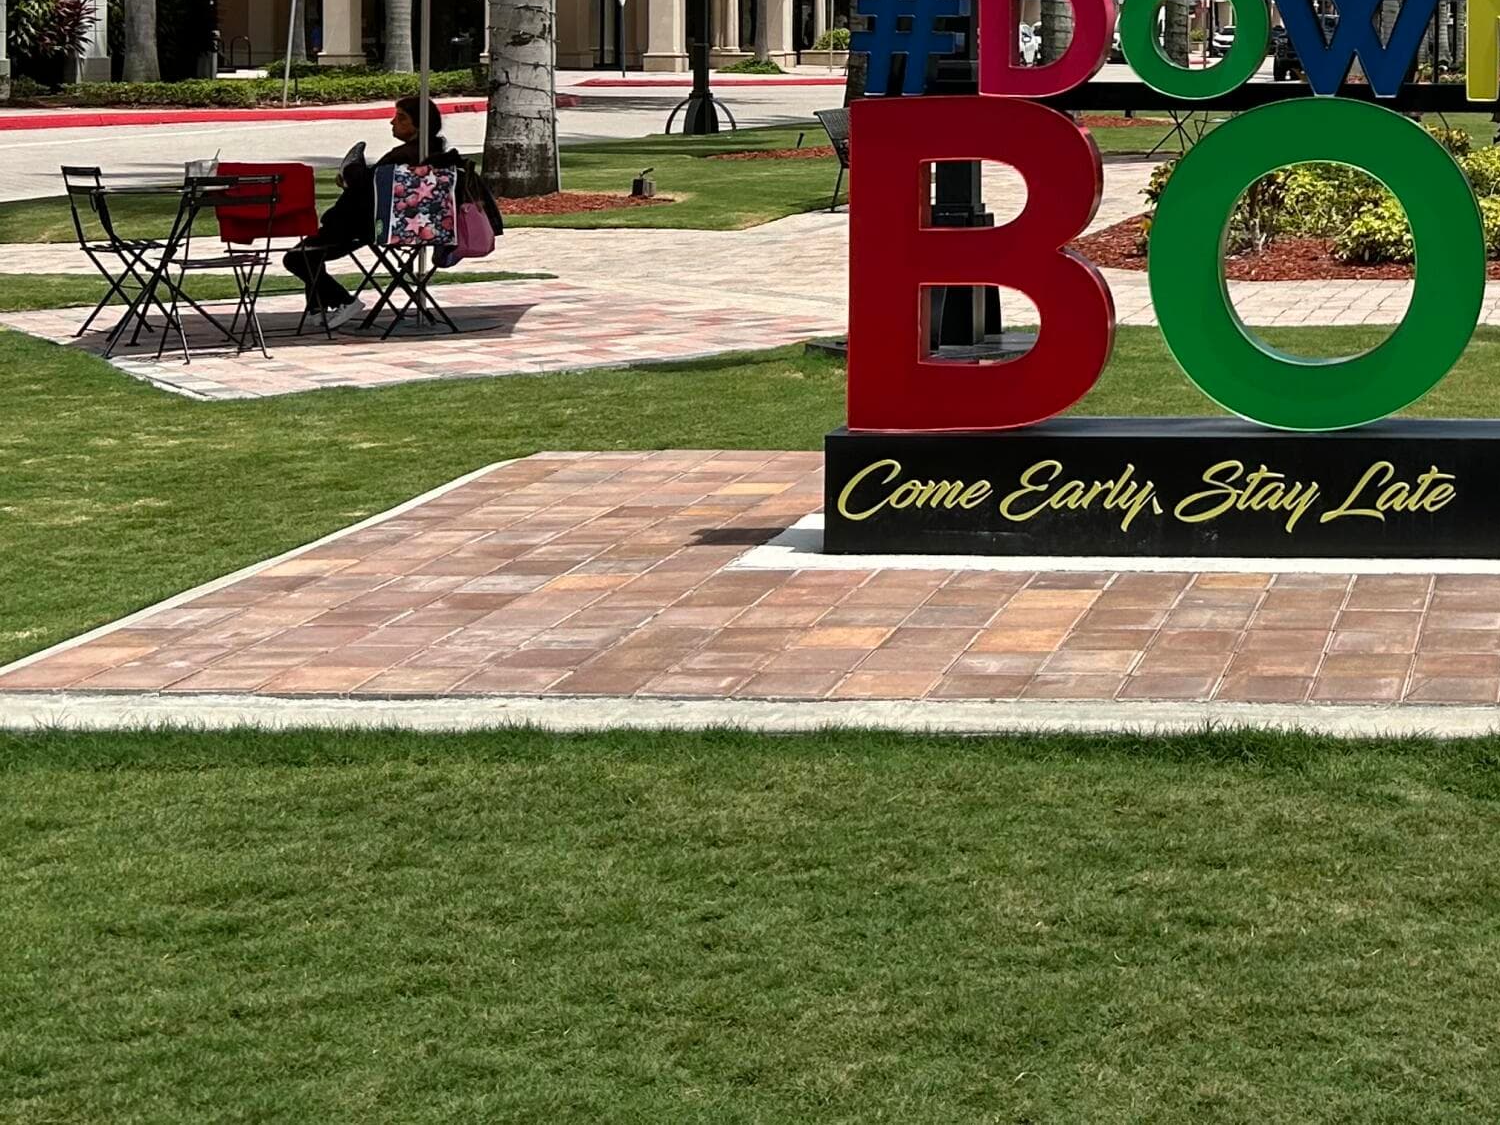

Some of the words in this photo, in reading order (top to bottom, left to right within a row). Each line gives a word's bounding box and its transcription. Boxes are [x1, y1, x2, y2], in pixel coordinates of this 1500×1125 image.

[837, 458, 991, 521] Come
[1173, 459, 1319, 533] Stay
[1320, 460, 1457, 523] Late
